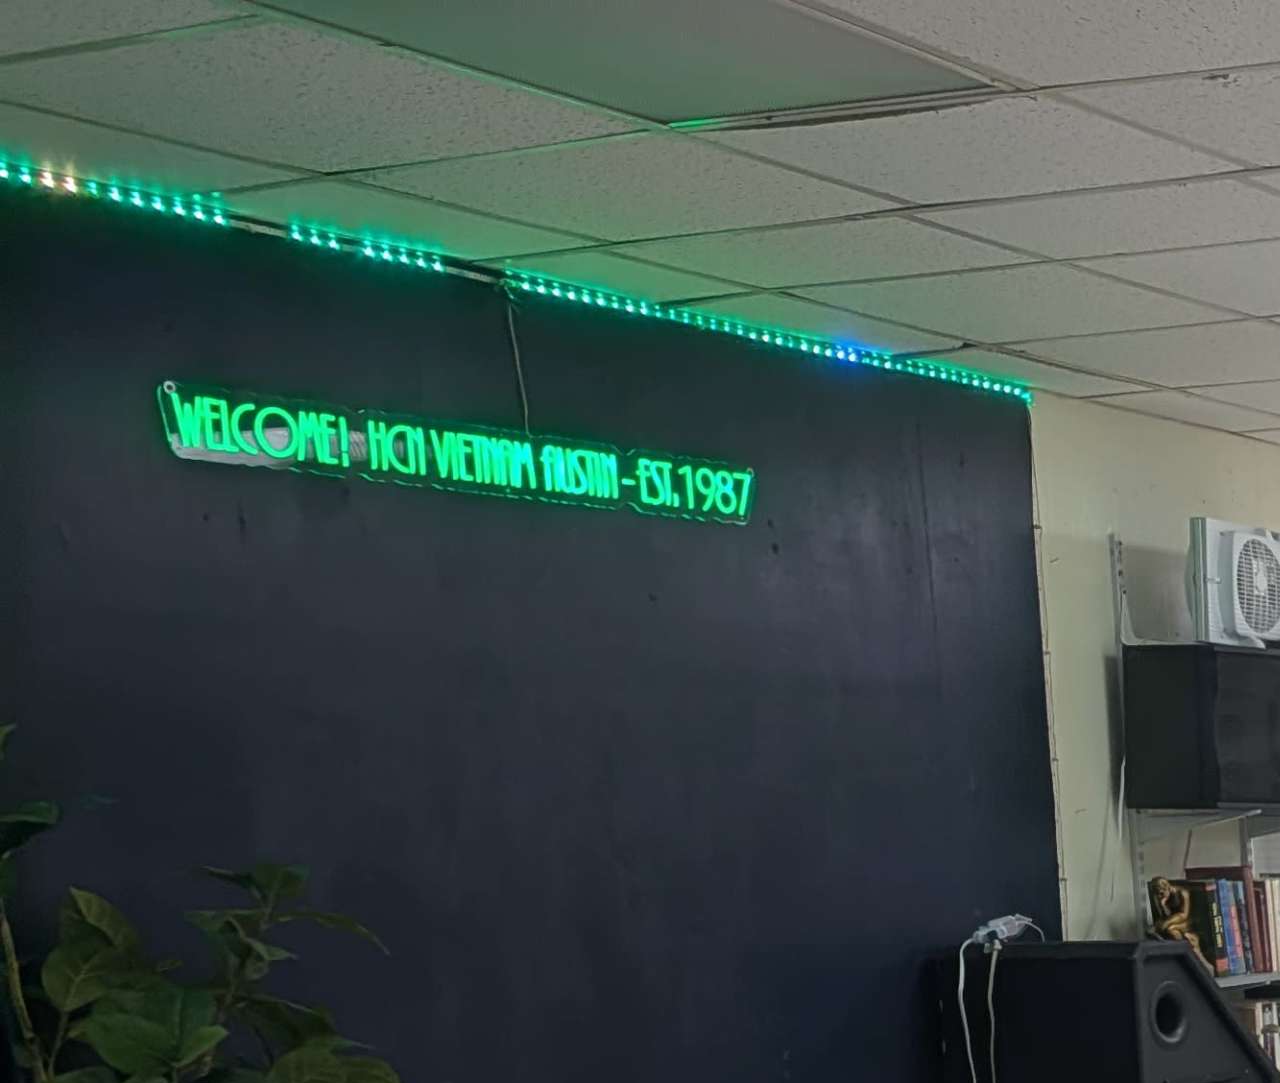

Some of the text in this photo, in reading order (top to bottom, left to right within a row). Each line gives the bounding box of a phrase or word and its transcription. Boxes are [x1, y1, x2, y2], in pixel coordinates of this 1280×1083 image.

[170, 391, 349, 467] WELCOME!
[429, 428, 537, 489] VIETNAM
[540, 444, 619, 500] AUSTIN
